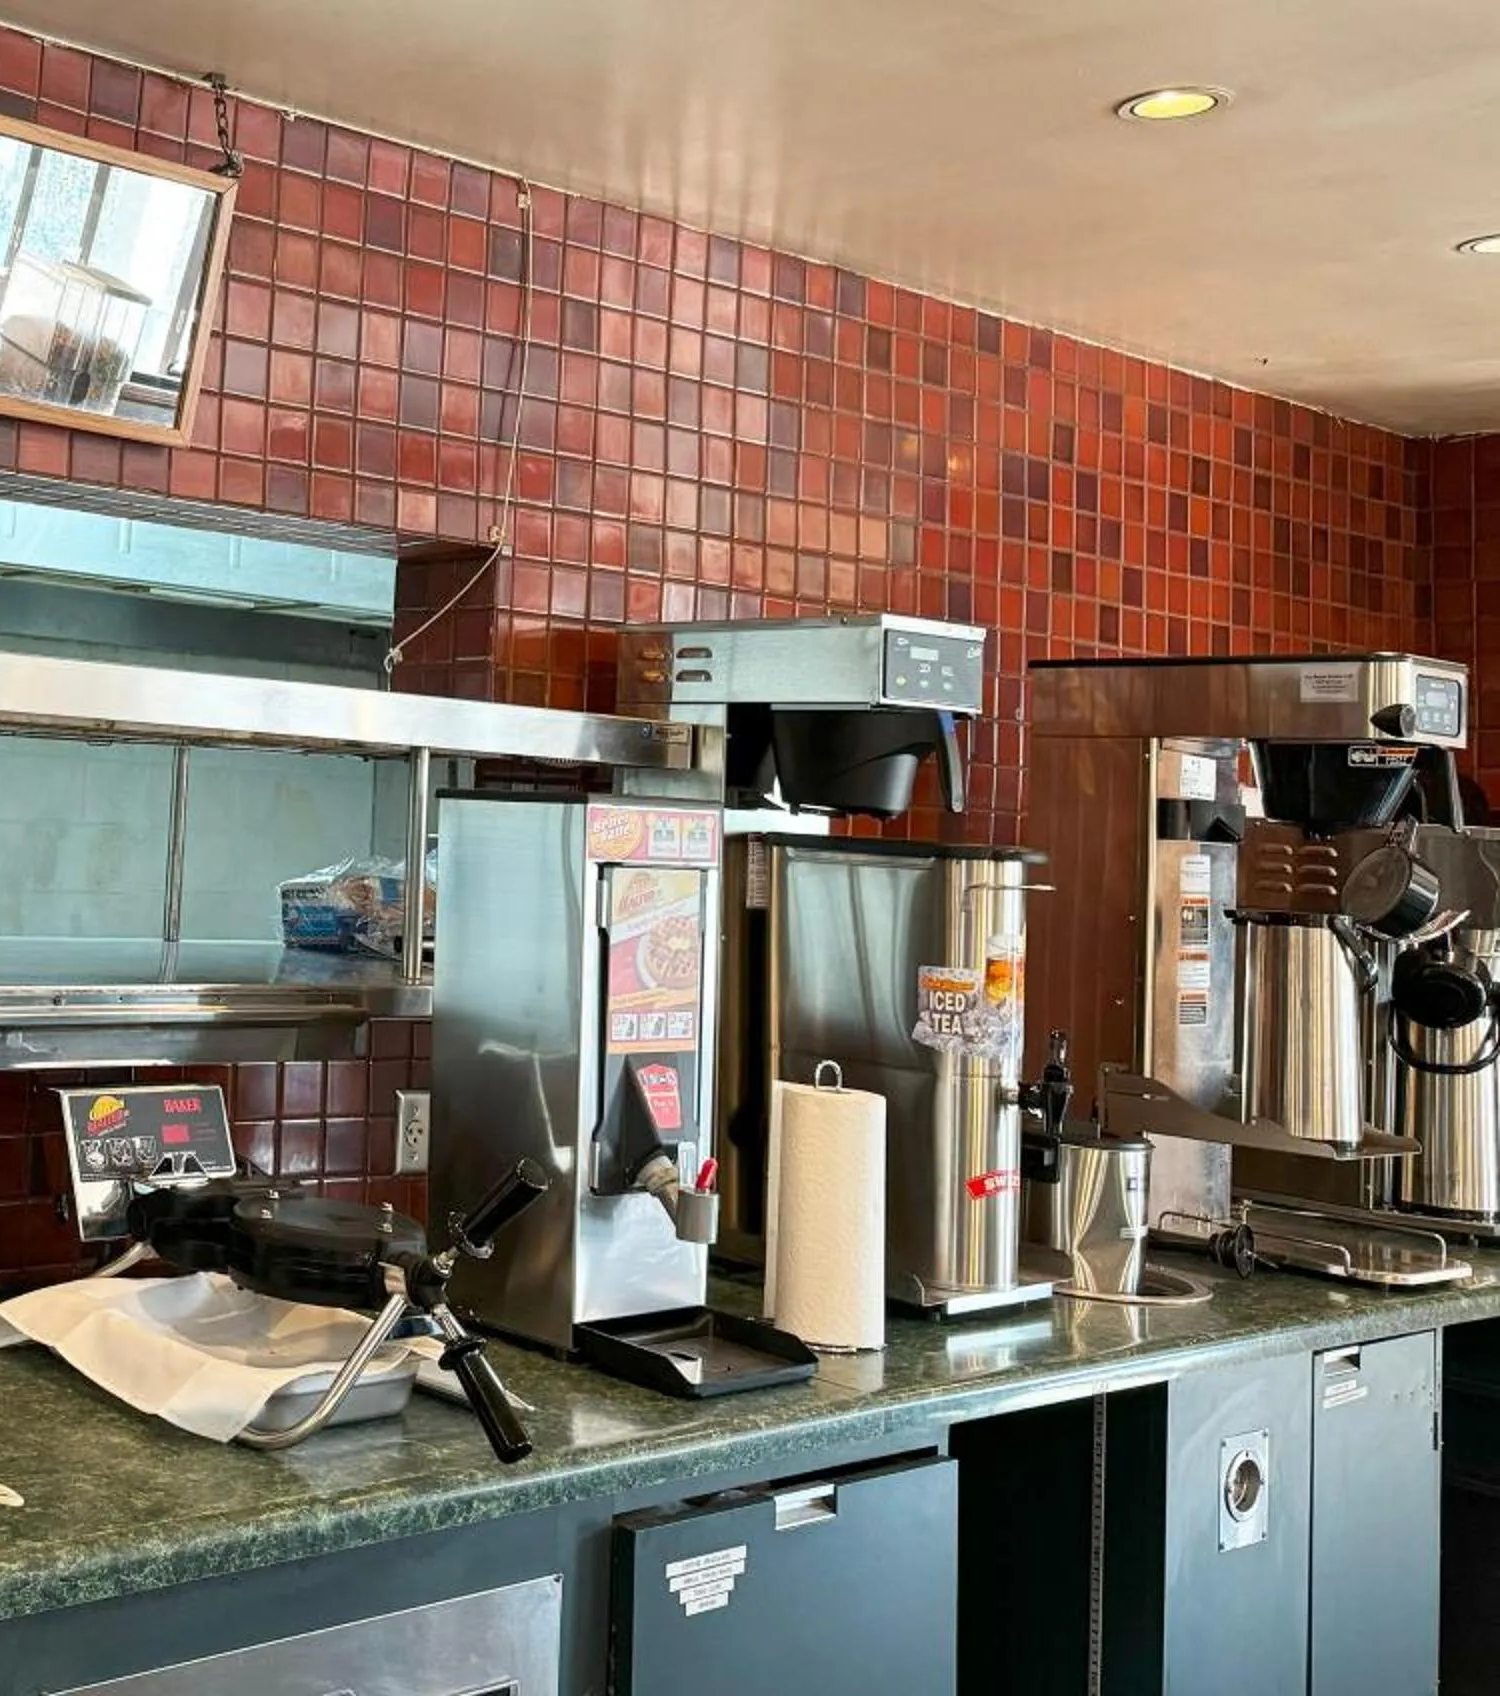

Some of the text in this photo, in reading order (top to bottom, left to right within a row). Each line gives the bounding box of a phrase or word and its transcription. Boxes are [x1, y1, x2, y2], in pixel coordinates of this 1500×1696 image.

[929, 991, 966, 1012] ICED
[932, 1013, 963, 1034] TEA
[164, 1098, 201, 1112] BAKER
